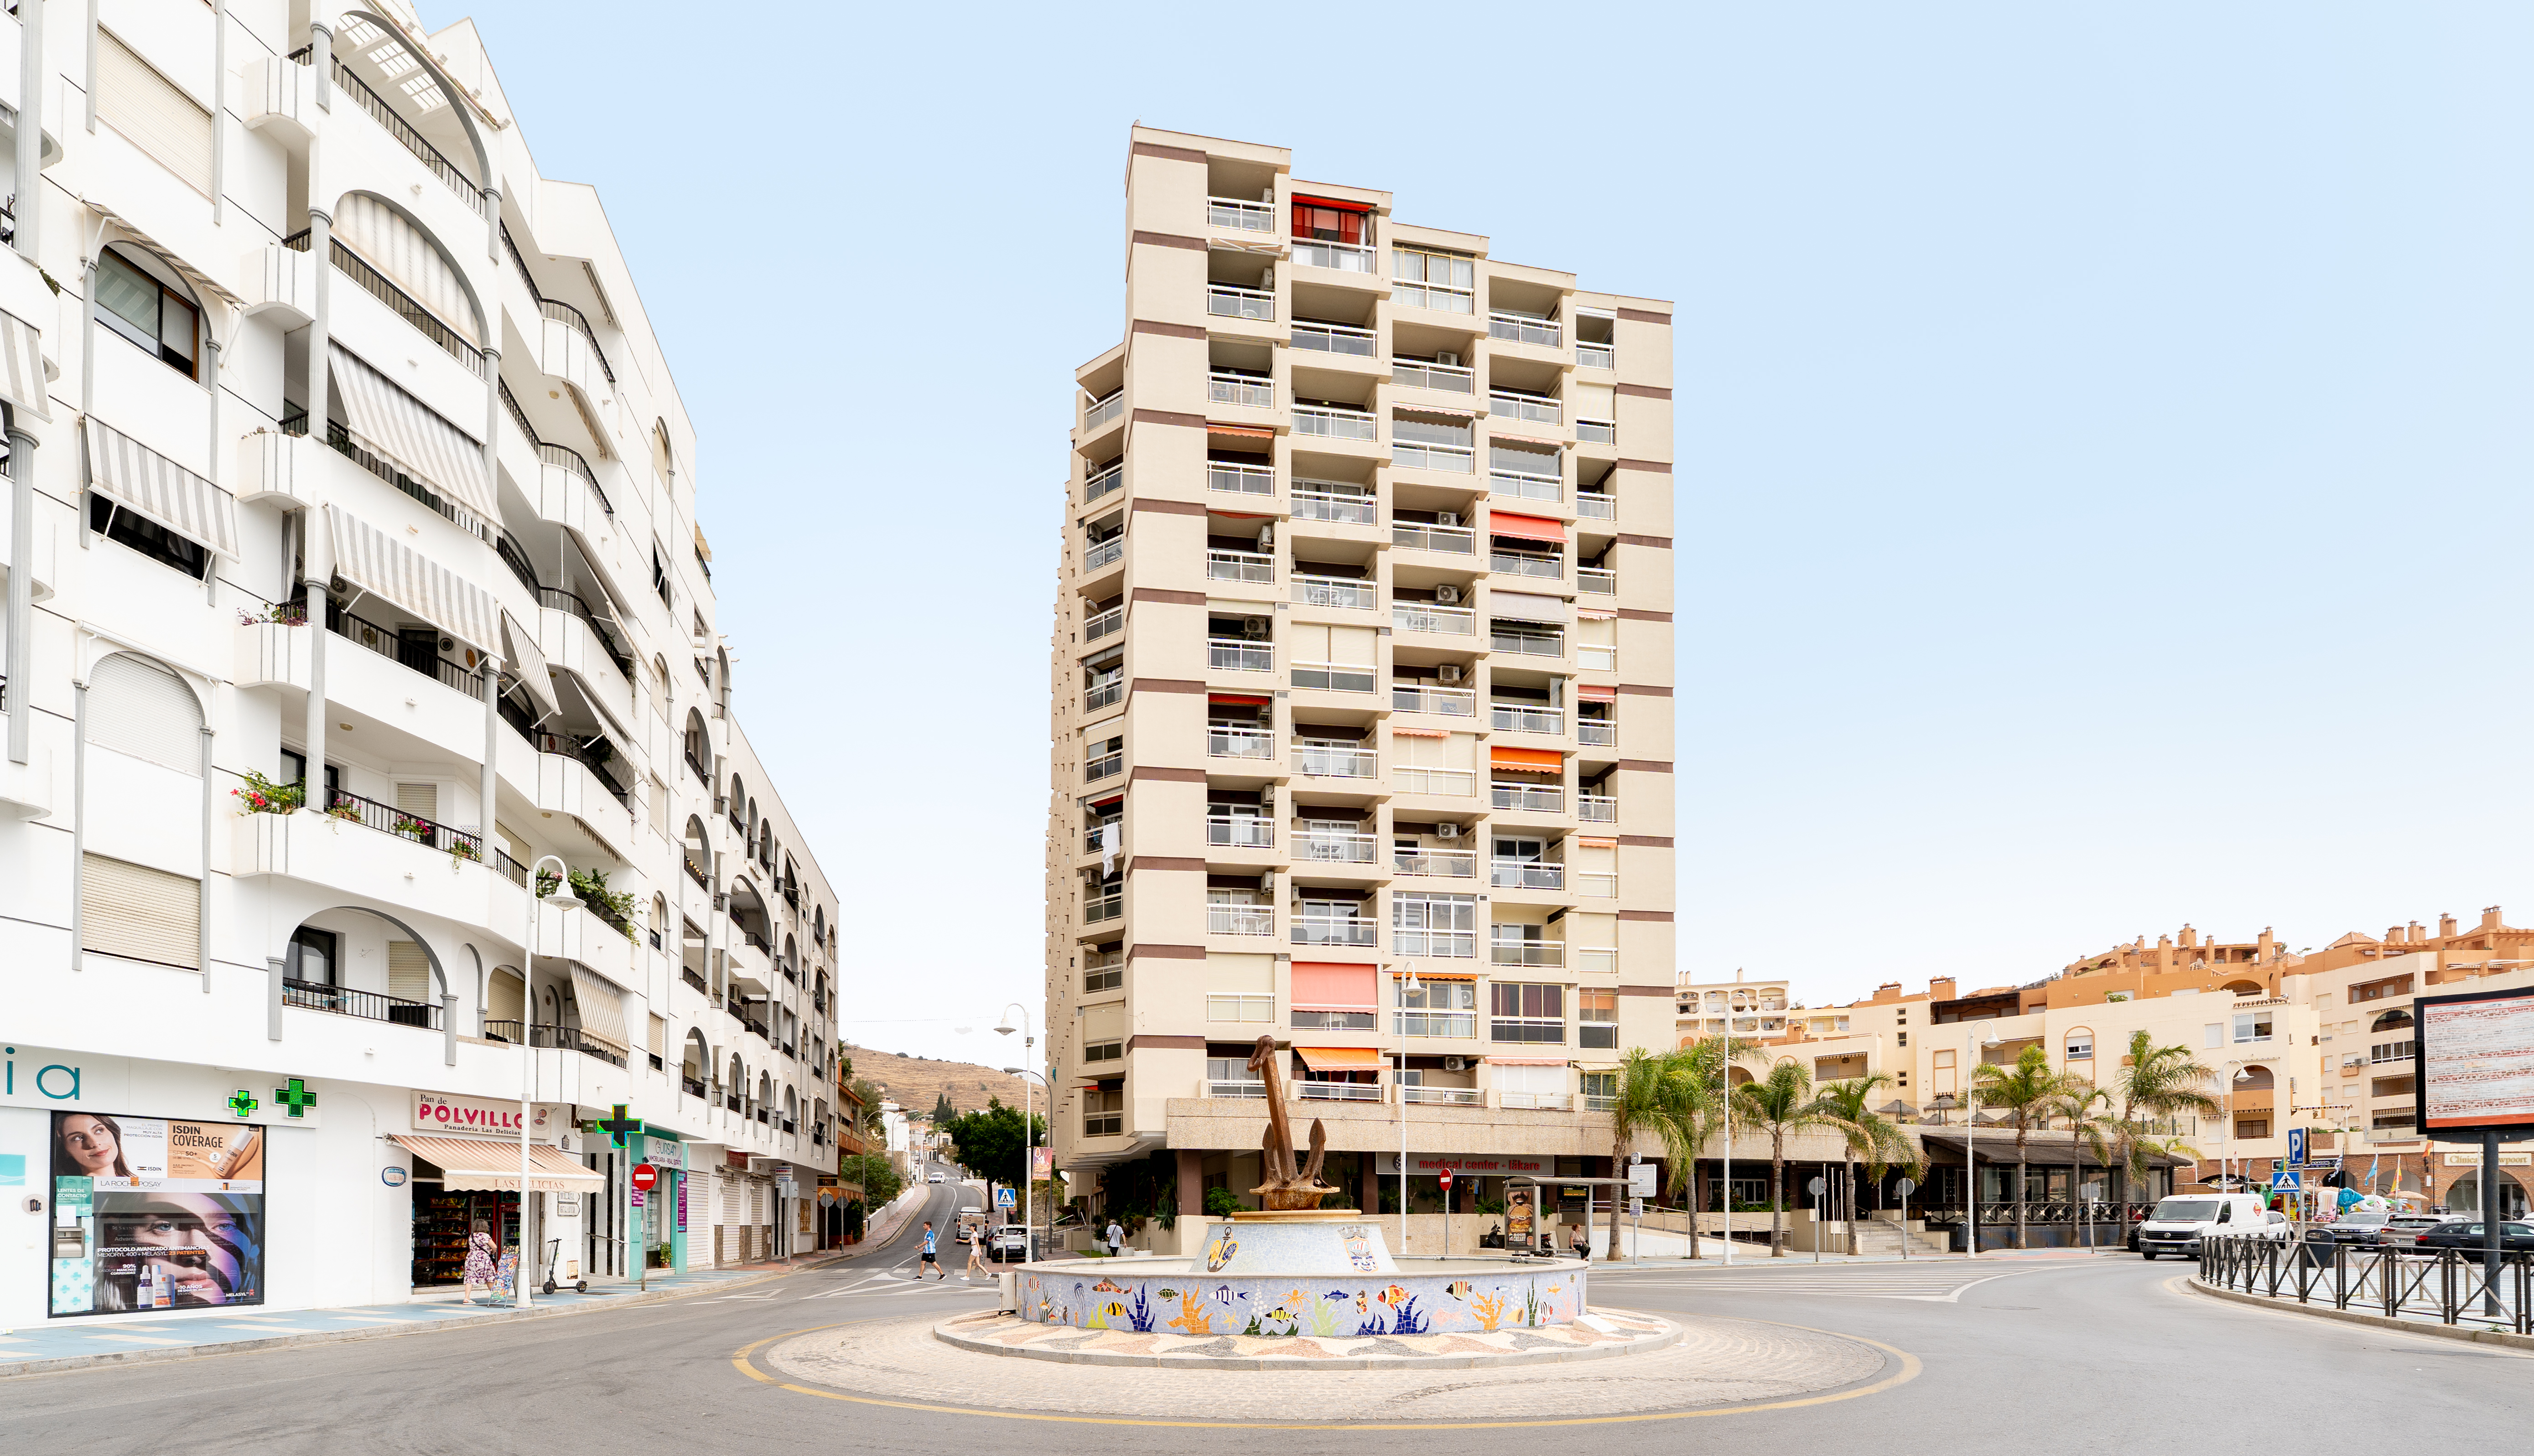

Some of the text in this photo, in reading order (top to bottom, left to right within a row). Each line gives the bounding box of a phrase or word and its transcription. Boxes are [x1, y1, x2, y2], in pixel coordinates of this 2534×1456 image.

[420, 1094, 435, 1103] Pan
[173, 1125, 201, 1135] ISDIN
[173, 1135, 223, 1148] COVERAGE
[2291, 1133, 2301, 1161] P
[1419, 1158, 1462, 1170] medical
[1465, 1159, 1500, 1170] center
[1509, 1160, 1541, 1171] läkare
[494, 1179, 514, 1188] LAS
